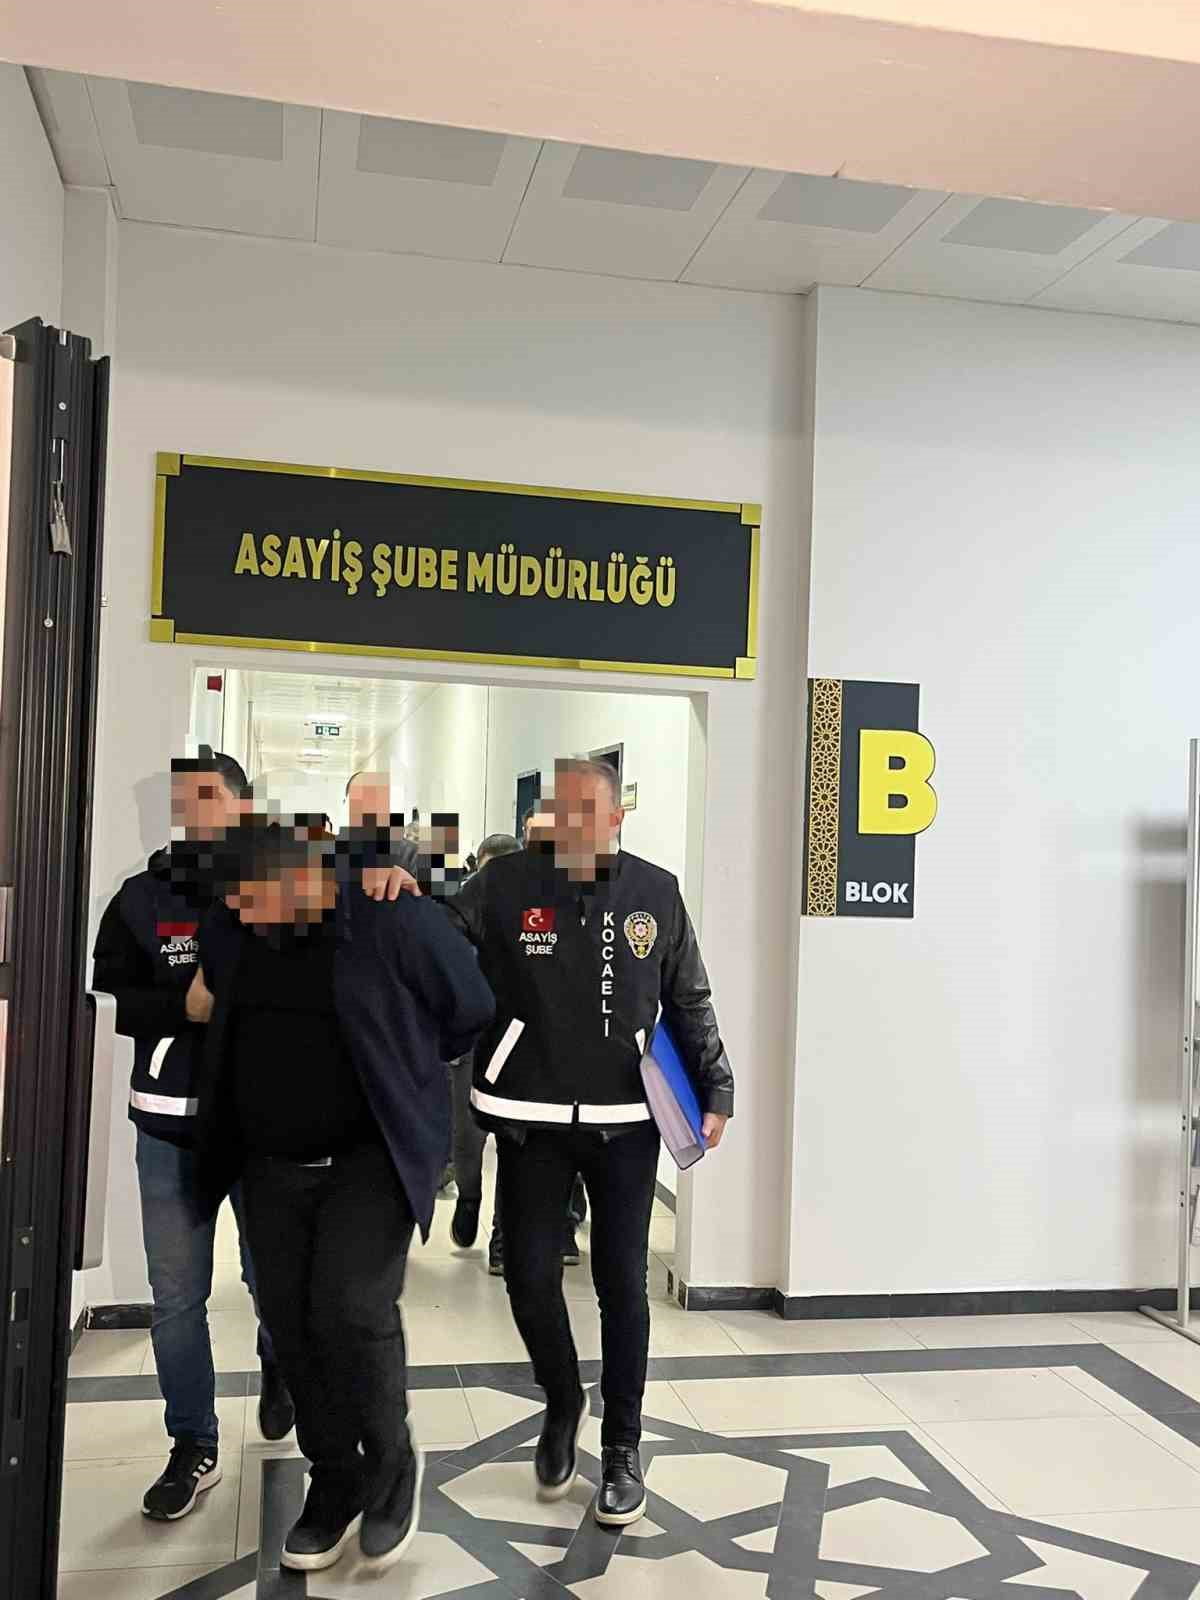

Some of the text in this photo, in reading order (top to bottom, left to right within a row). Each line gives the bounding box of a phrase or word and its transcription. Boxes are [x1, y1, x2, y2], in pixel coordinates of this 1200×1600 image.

[234, 528, 676, 607] ASAYİŞ ŞUBE MÜDÜRLÜĞÜ
[857, 728, 938, 836] B
[845, 881, 909, 904] BLOK
[518, 931, 558, 945] ASAYİŞ
[525, 944, 553, 956] ŞUBE
[600, 911, 615, 1038] KOCAELİ
